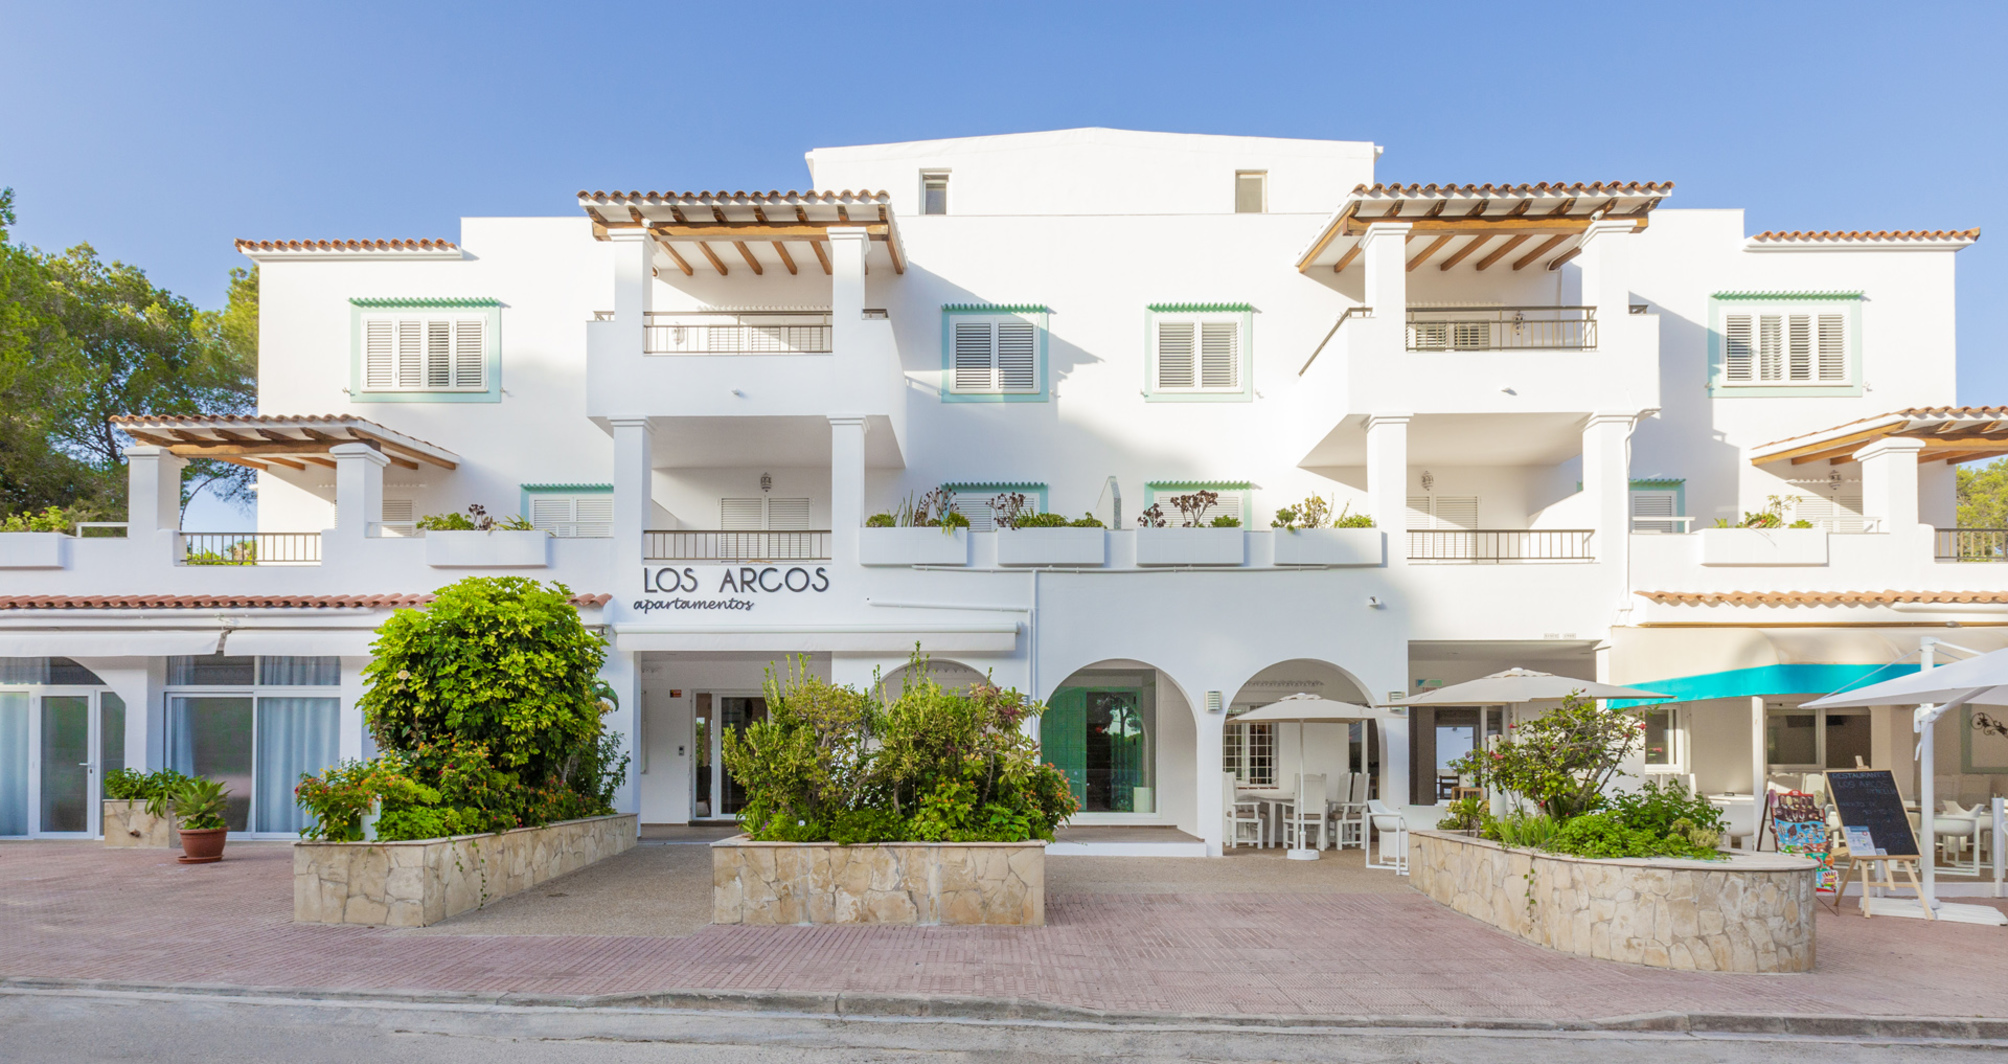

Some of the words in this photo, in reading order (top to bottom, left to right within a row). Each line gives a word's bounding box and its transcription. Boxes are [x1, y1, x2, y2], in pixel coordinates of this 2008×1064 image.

[644, 567, 698, 593] LOS
[719, 567, 830, 593] ARCOS
[633, 598, 755, 614] apartamentos
